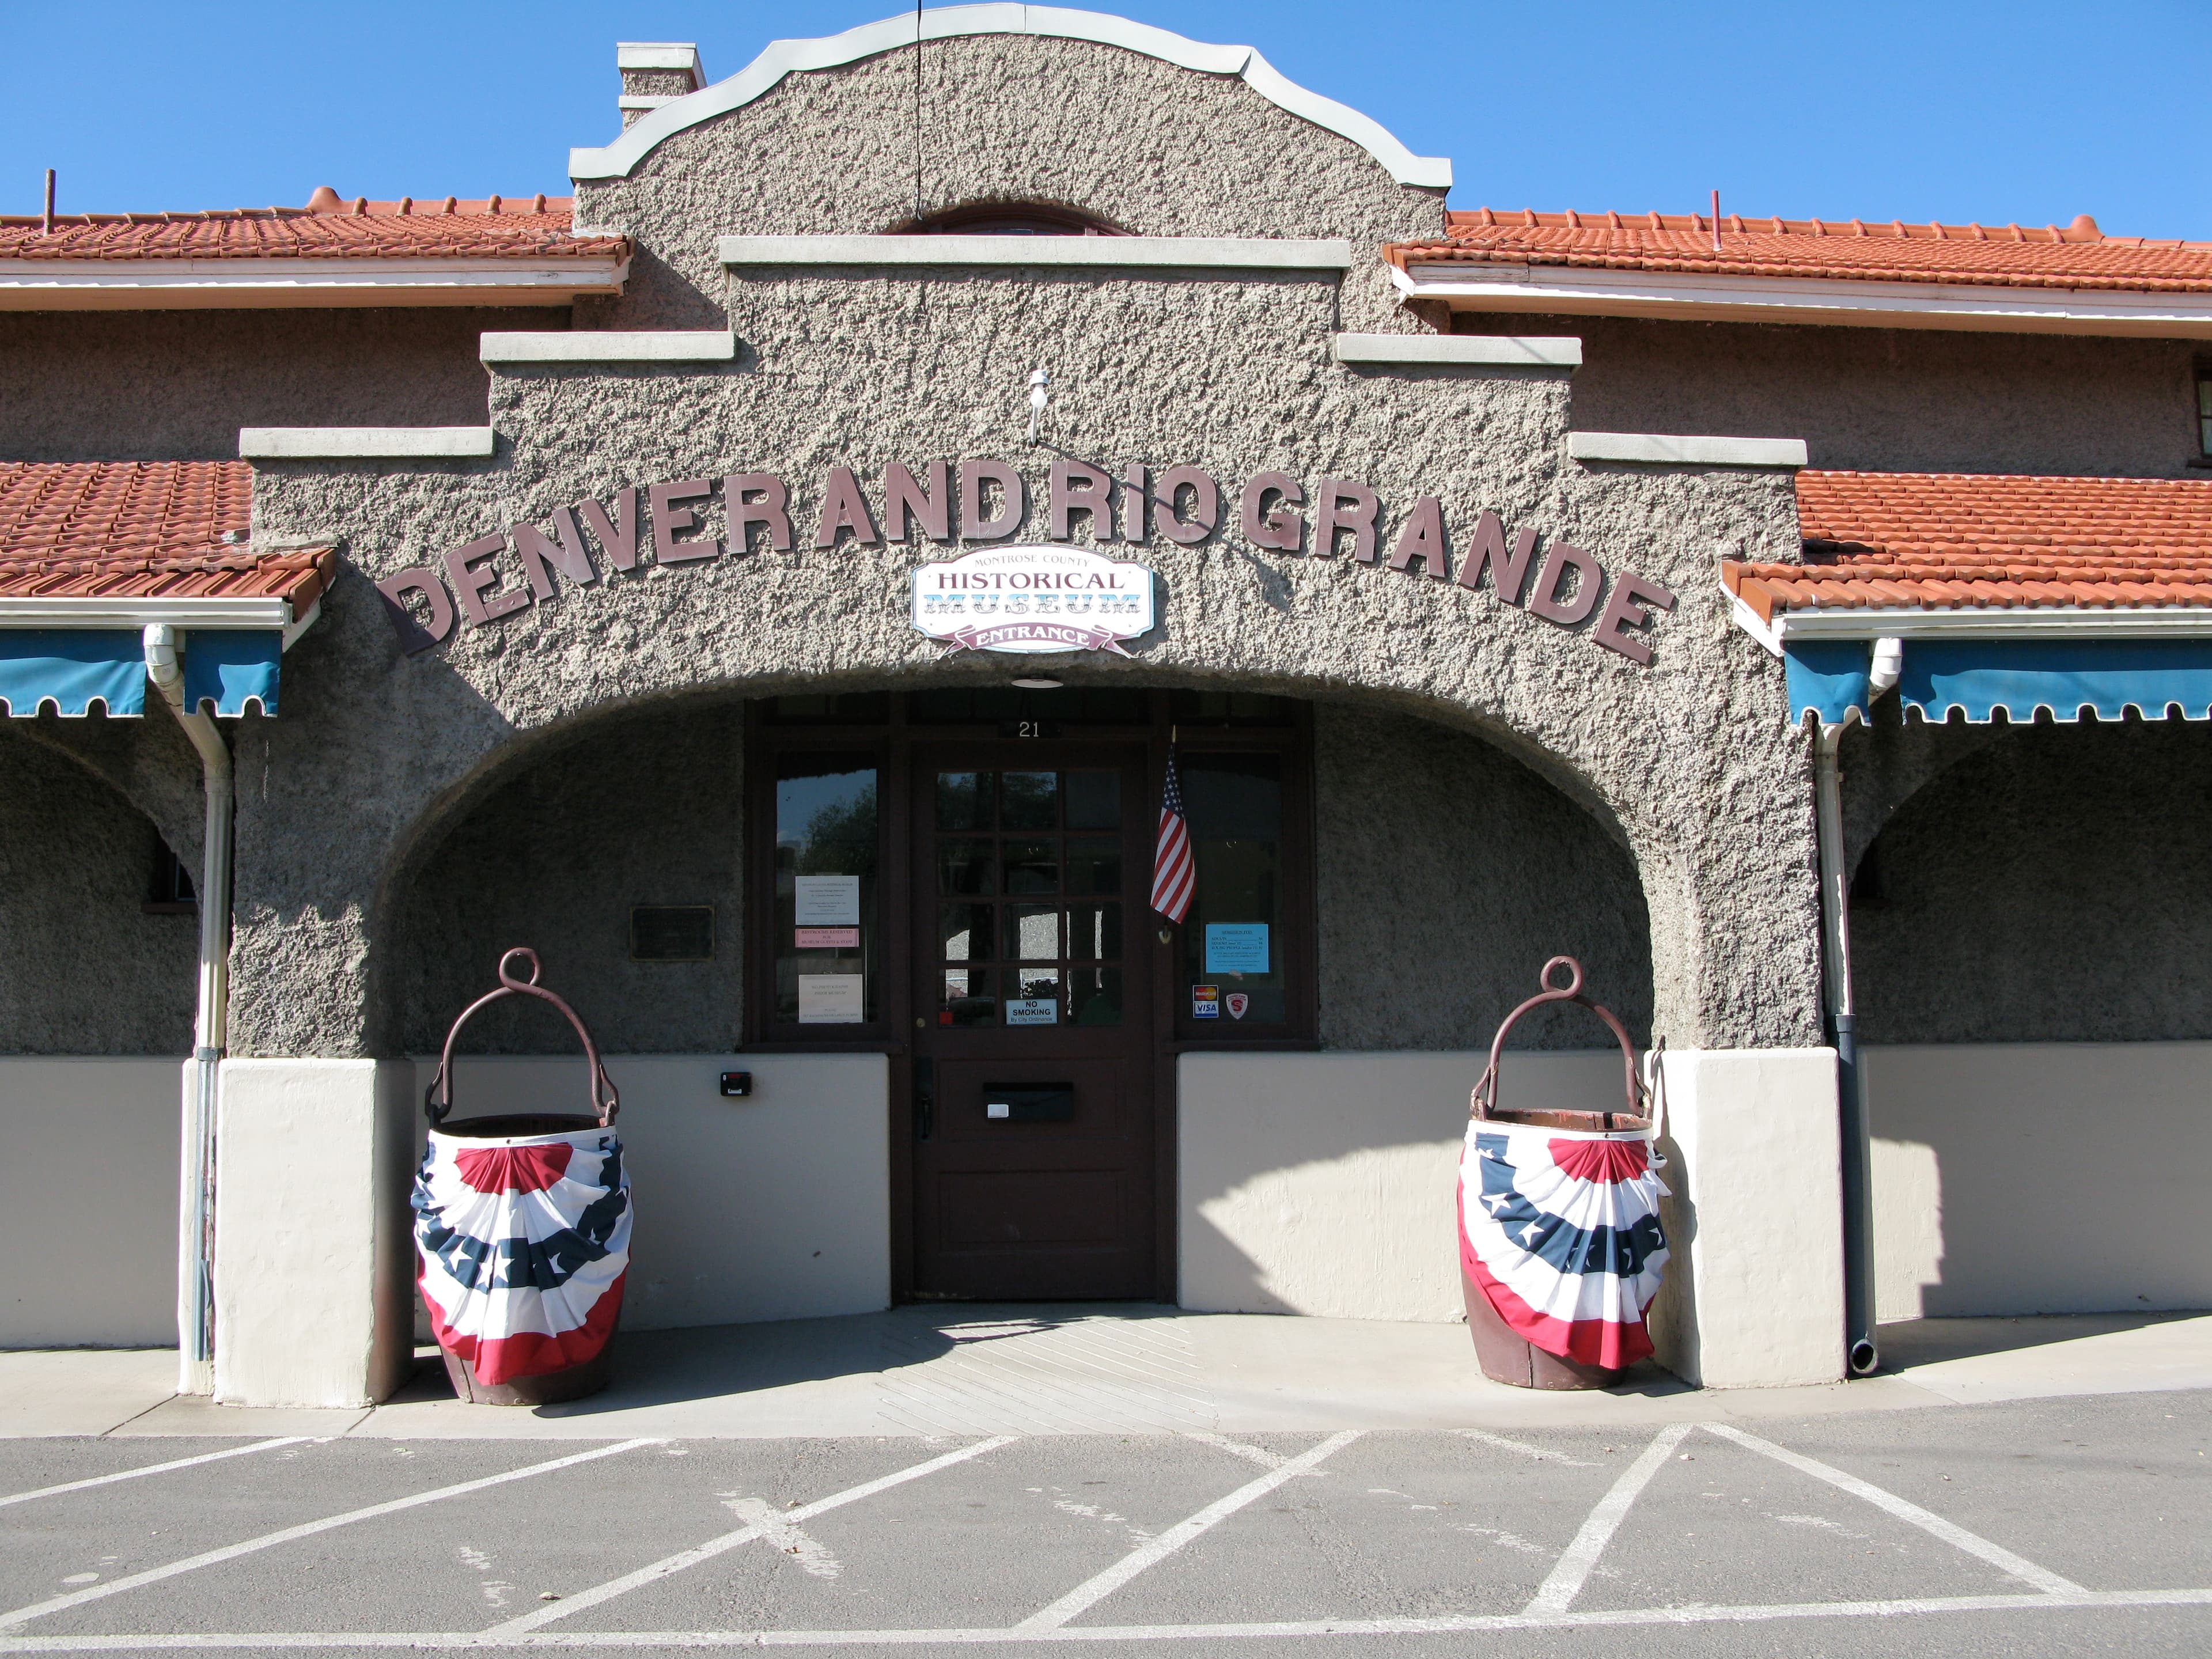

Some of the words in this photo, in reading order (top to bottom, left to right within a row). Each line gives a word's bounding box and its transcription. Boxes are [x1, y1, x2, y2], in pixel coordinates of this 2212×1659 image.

[375, 472, 791, 656] DENVER
[815, 459, 1024, 548] AND
[1049, 459, 1217, 544] RIO
[1241, 471, 1678, 666] GRANDE
[974, 554, 1037, 567] MONTROSE
[1043, 554, 1090, 568] COUNTY
[938, 572, 1126, 589] HISTORICAL
[923, 593, 1141, 614] MUSEUM
[975, 625, 1090, 647] ENTRANCE
[1018, 721, 1039, 738] 21
